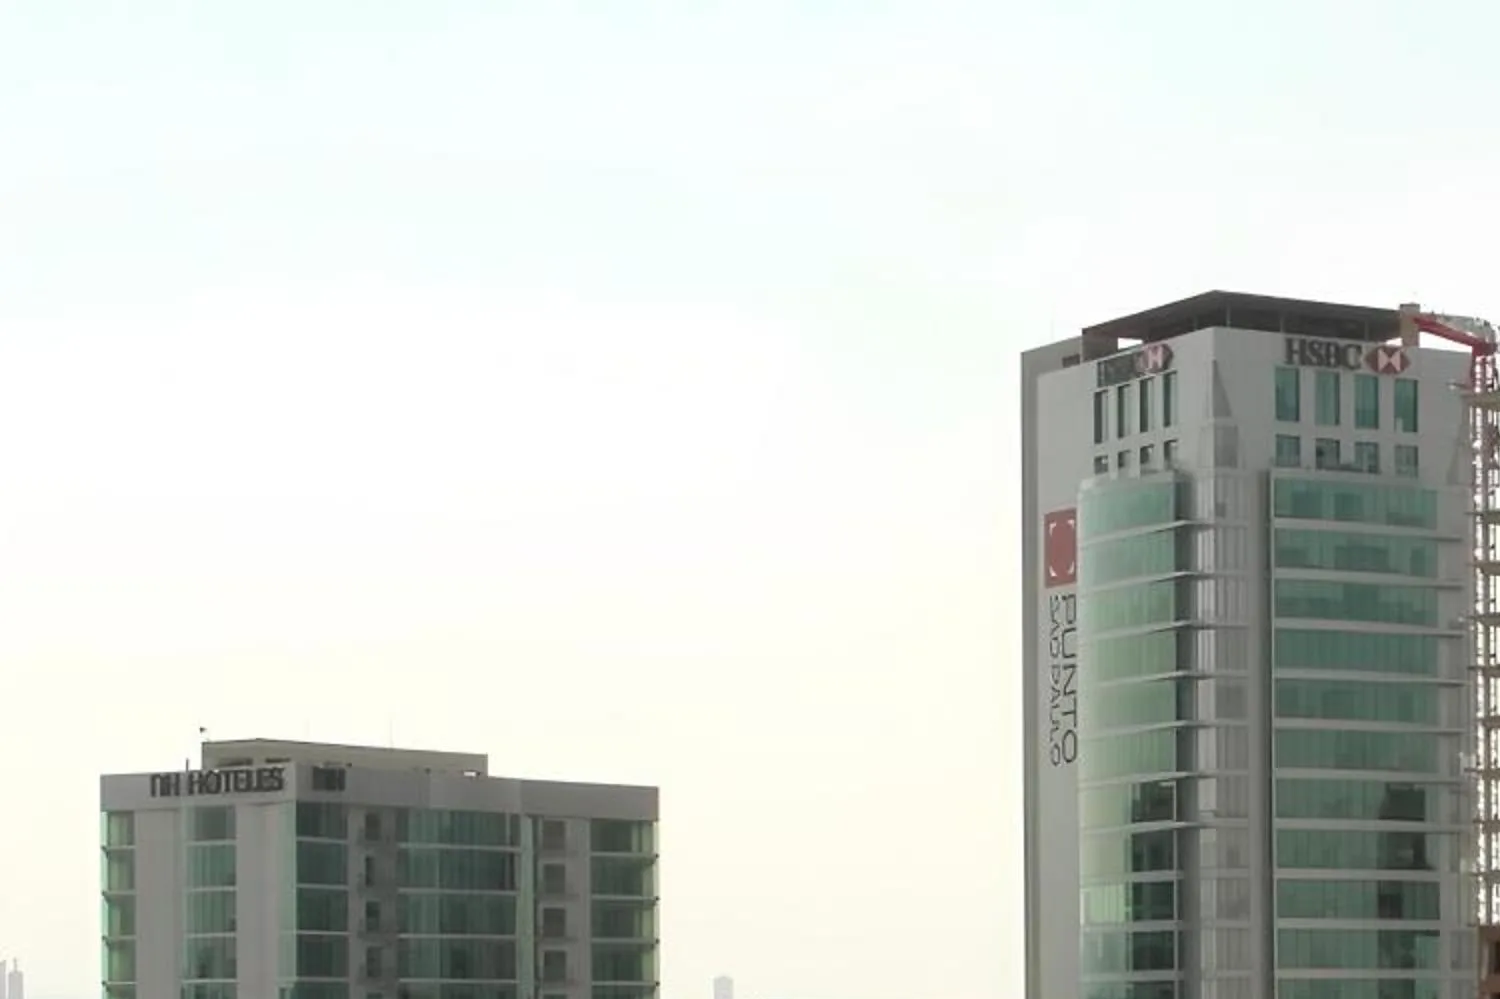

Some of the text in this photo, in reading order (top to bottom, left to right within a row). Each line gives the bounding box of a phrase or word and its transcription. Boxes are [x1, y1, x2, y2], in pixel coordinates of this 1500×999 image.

[1285, 337, 1362, 370] HSBC
[1061, 594, 1077, 763] PUNTO
[188, 767, 284, 796] HOTELES
